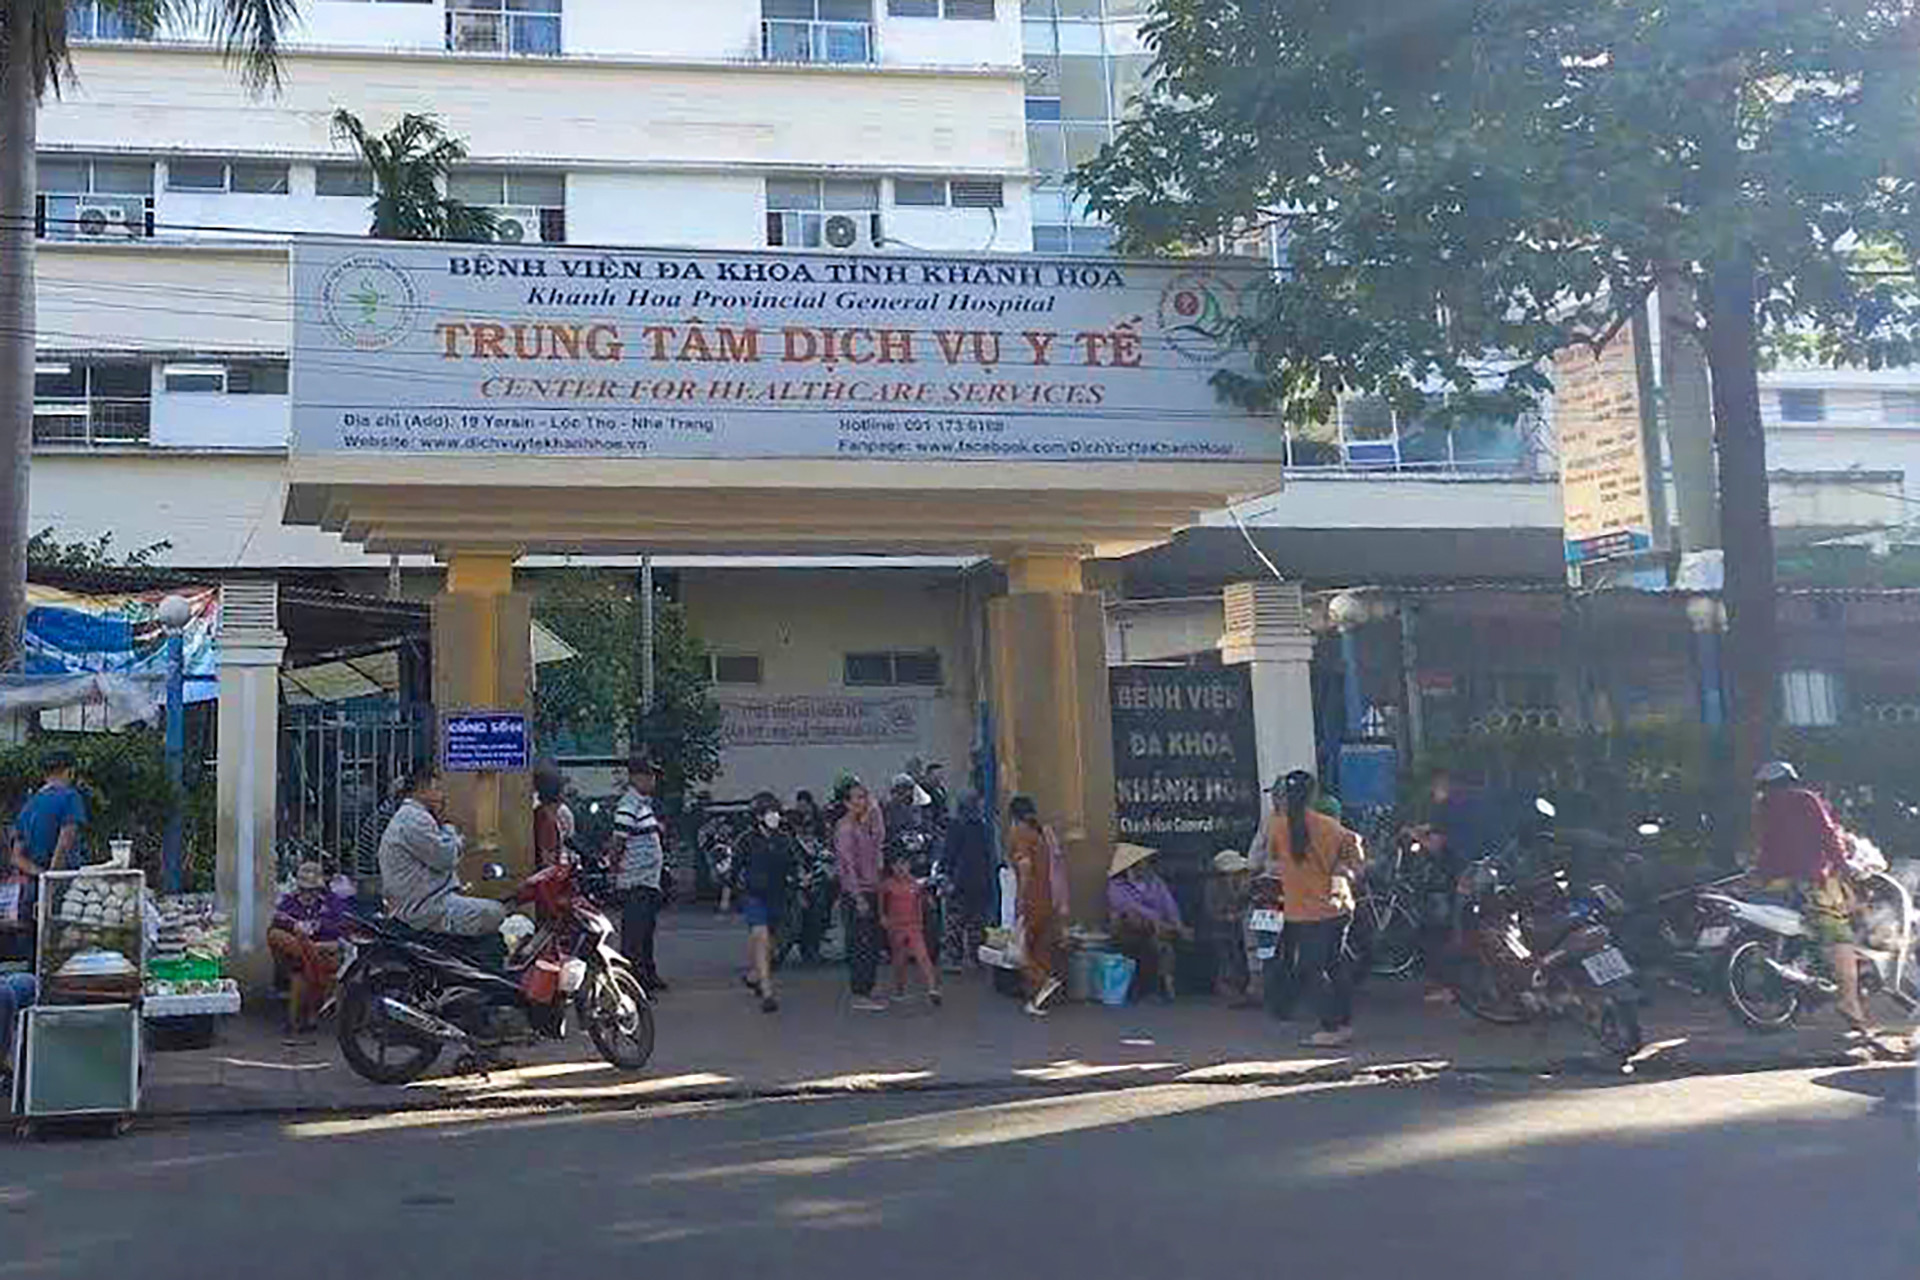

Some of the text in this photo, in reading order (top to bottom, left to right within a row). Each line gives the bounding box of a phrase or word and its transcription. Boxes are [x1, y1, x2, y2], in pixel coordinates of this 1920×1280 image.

[658, 261, 704, 280] ĐA
[717, 261, 813, 282] KHOA
[527, 287, 1056, 316] Khanh Hoa Provincial General Hospital
[436, 322, 625, 362] TRUNG
[643, 316, 760, 363] TÂM
[780, 327, 916, 373] DỊCH
[933, 329, 1004, 375] VỤ
[1022, 331, 1054, 367] Y
[1076, 316, 1145, 368] TẾ
[480, 376, 1107, 405] CENTER FOR HEALTHCARE SERVICES
[1167, 731, 1236, 760] KHOA
